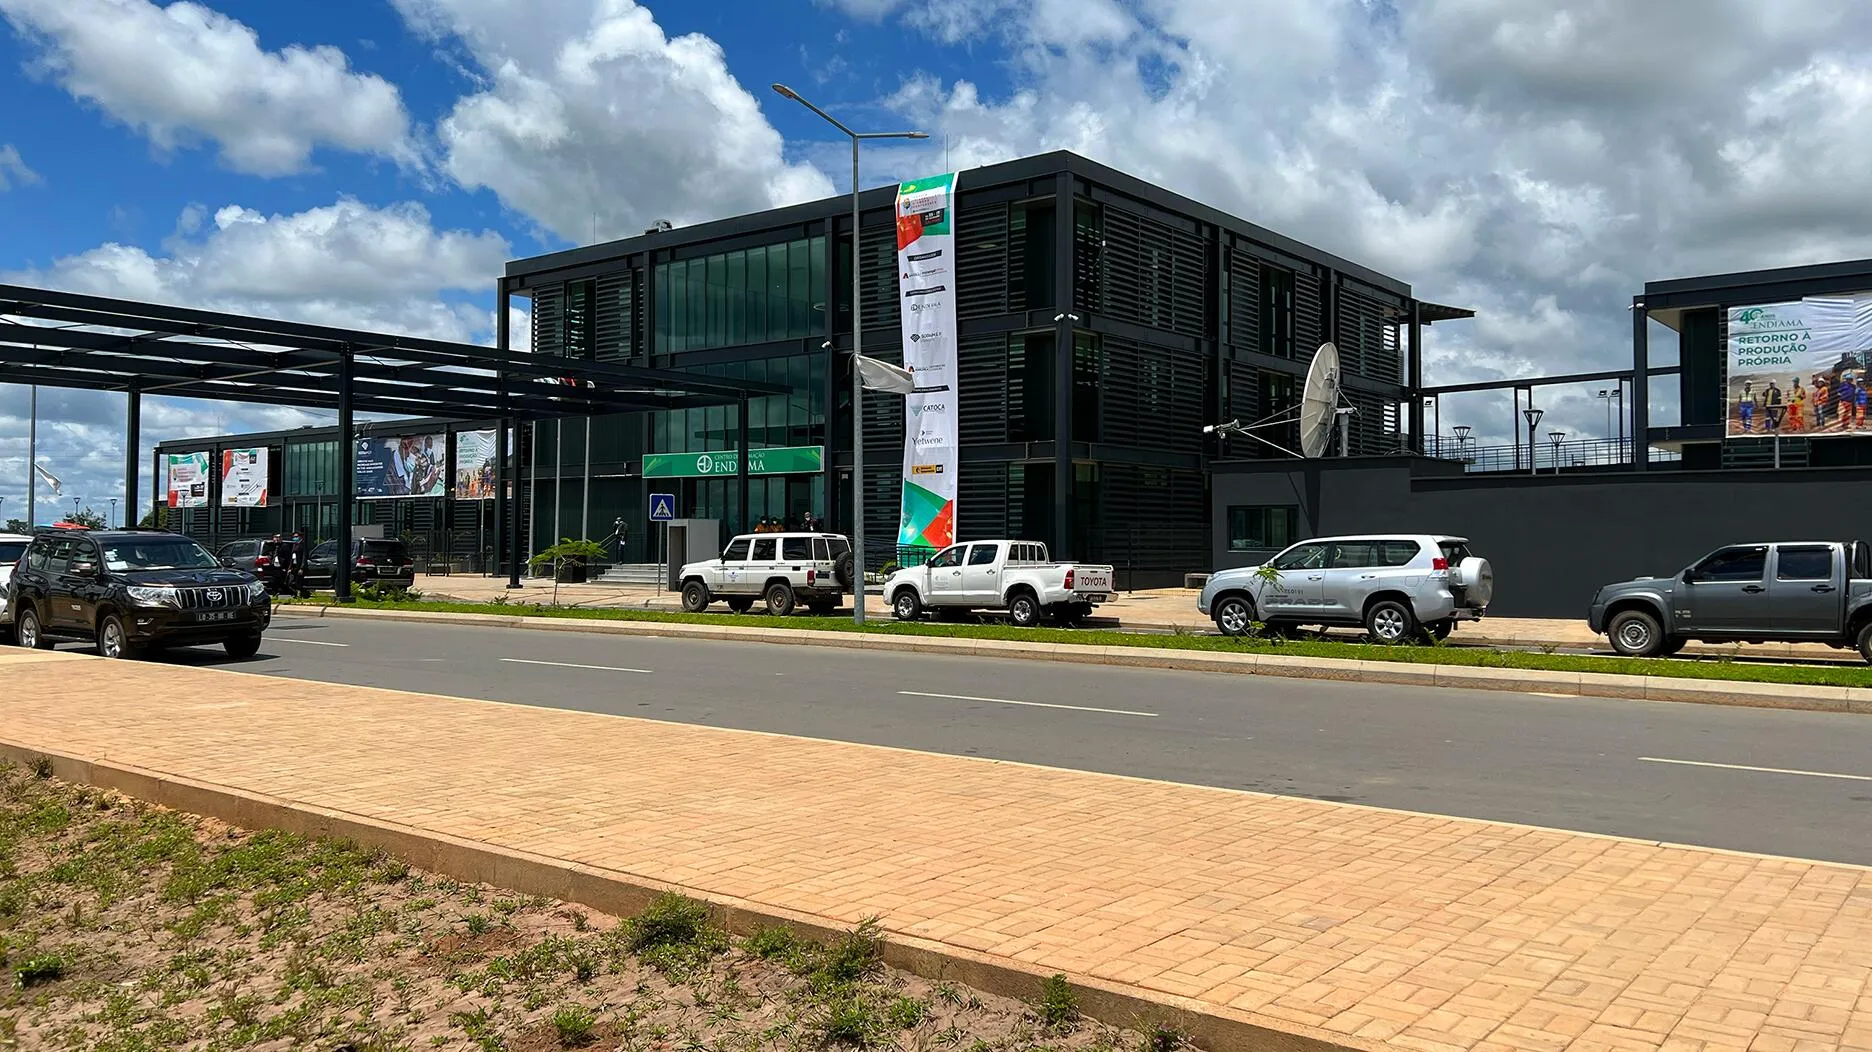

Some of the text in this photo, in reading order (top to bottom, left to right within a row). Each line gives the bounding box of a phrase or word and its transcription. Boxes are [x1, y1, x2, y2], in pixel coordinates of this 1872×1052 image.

[1753, 320, 1803, 329] ENDIAMA
[1739, 330, 1811, 344] RETORNO À
[1738, 343, 1807, 355] PRODUÇÃO
[1738, 355, 1791, 366] PRÓPRIA
[912, 437, 943, 445] Yetwene
[715, 460, 765, 472] ENDMA
[1081, 577, 1107, 586] TOYOTA
